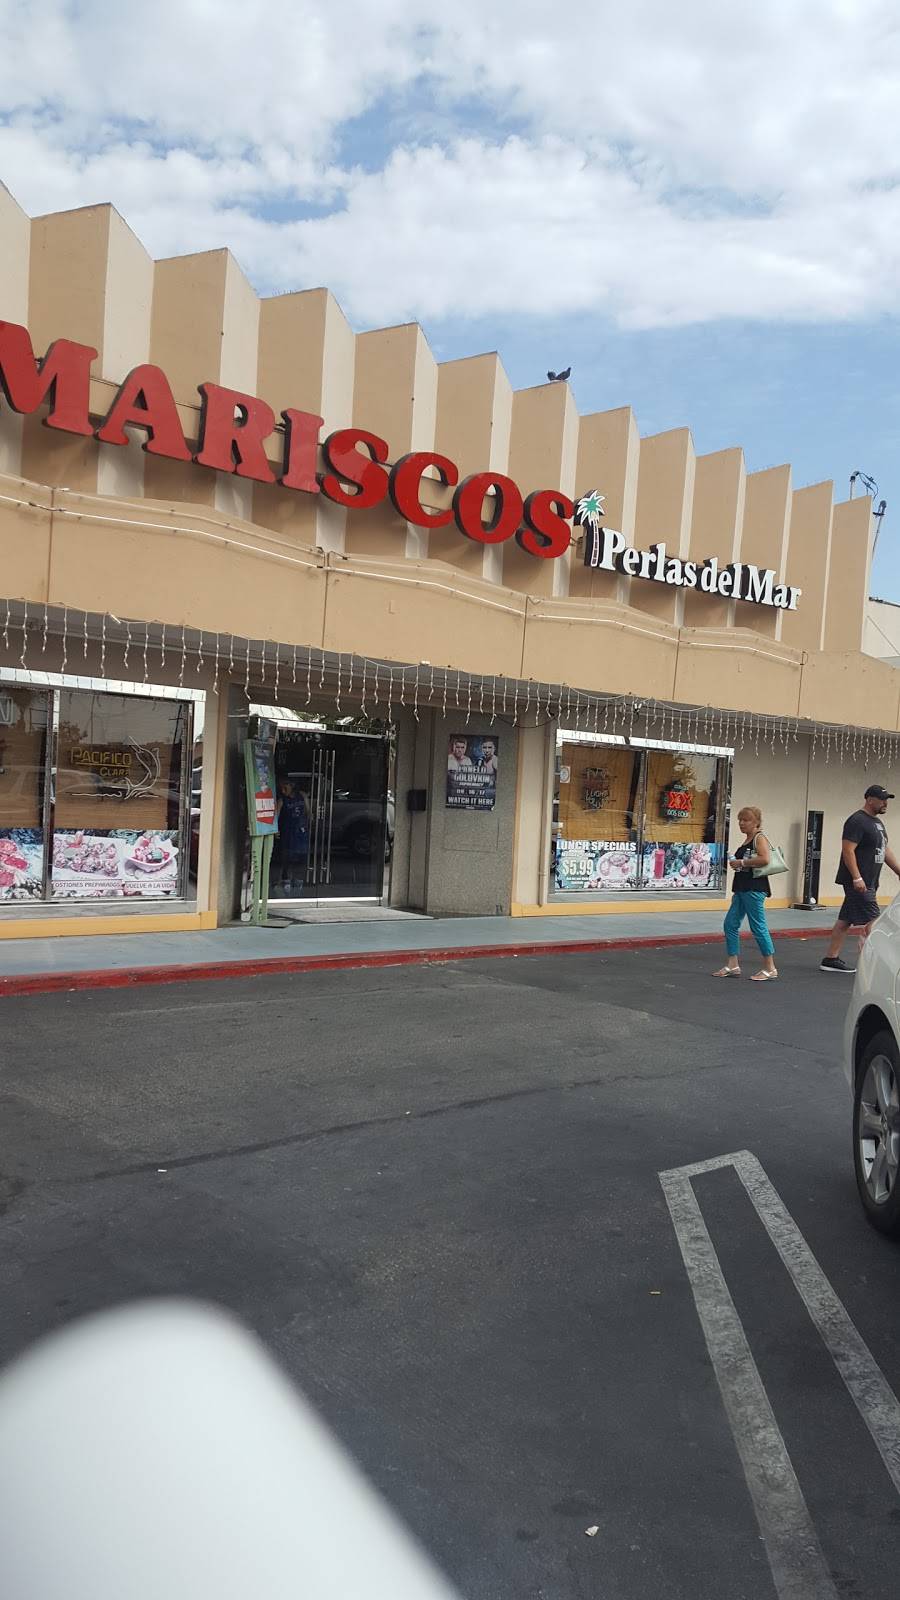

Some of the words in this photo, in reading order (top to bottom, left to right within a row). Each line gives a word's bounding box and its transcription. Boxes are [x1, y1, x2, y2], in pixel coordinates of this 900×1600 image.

[0, 320, 574, 558] MARISCOS
[600, 527, 697, 588] Perlas
[701, 558, 743, 599] del
[747, 564, 802, 611] Mar
[71, 747, 132, 765] PACIFICO
[447, 796, 470, 805] WATCH
[479, 798, 494, 806] HERE
[556, 840, 589, 850] LUNCH
[591, 841, 637, 852] SPECIALS
[562, 858, 594, 876] $5.99
[54, 881, 84, 889] OSTIONES
